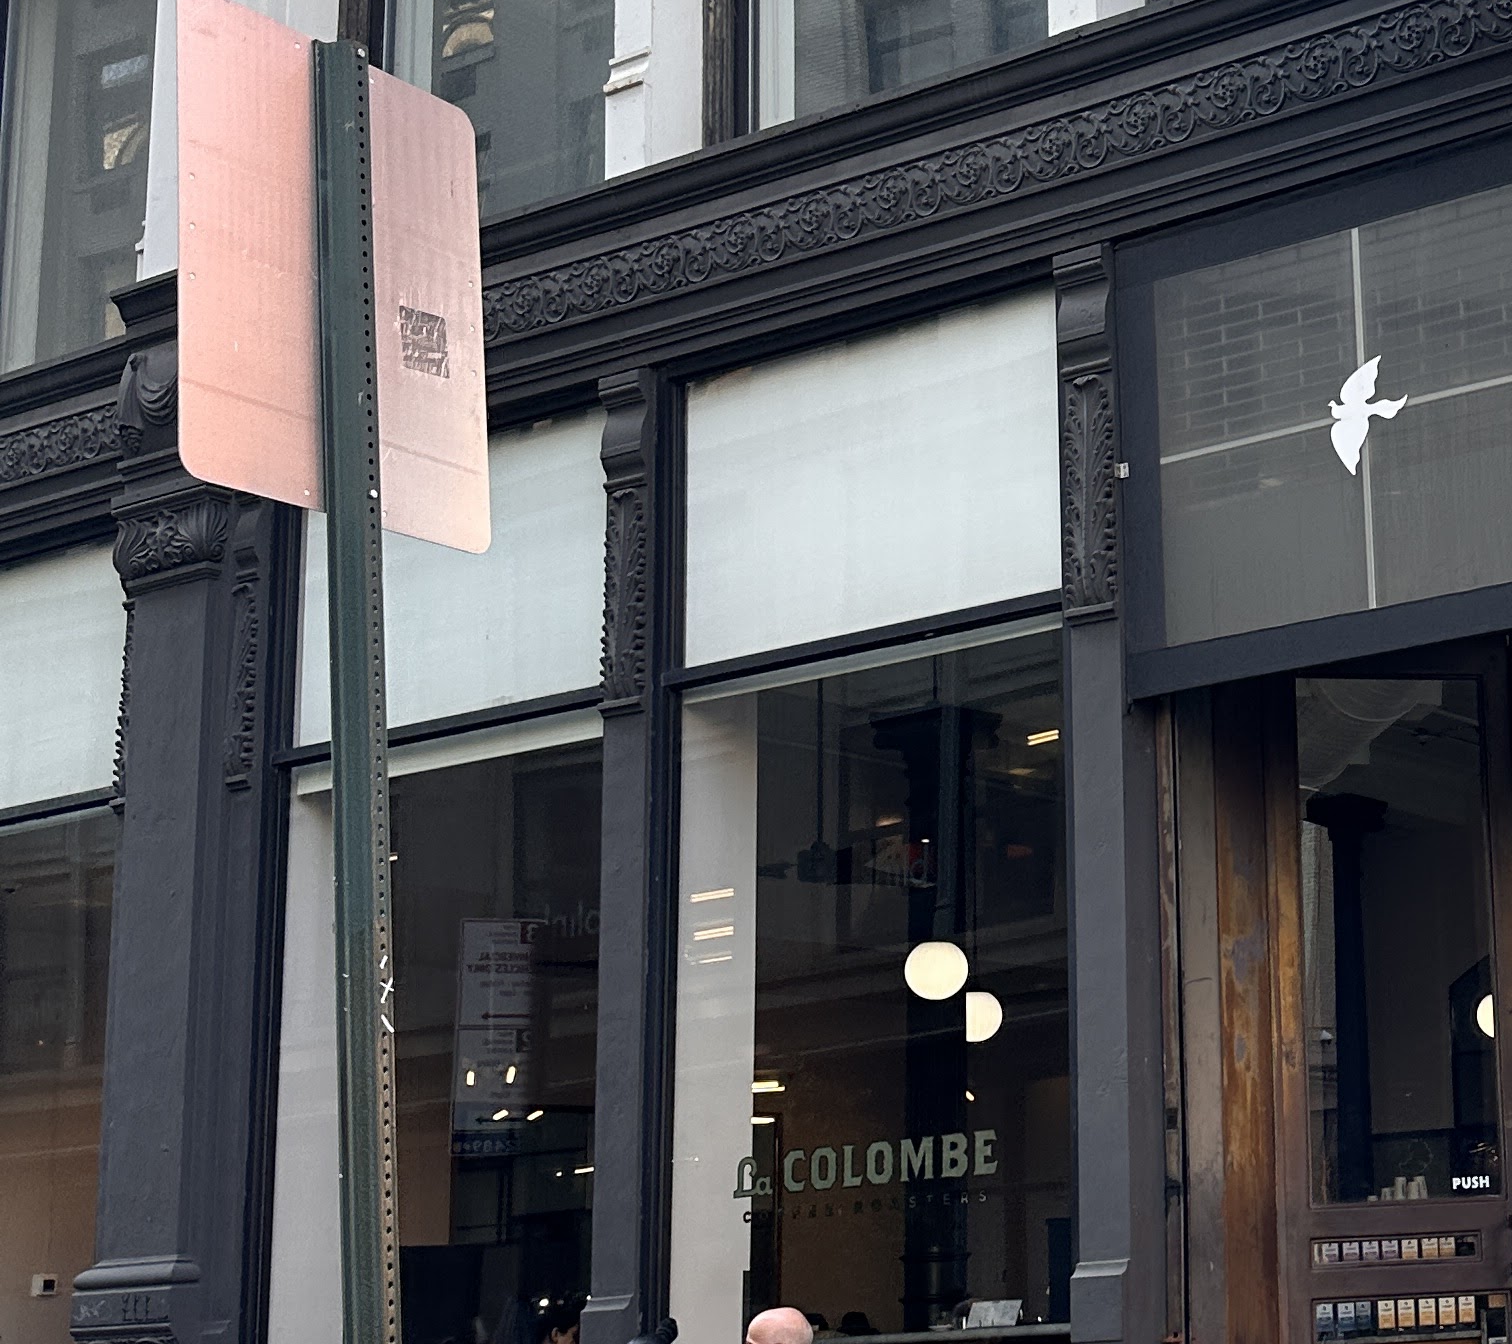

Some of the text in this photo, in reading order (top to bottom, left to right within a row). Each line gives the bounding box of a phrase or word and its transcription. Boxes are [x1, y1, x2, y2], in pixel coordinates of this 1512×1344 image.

[733, 1129, 998, 1198] La COLOMBE
[1452, 1175, 1490, 1190] PUSH
